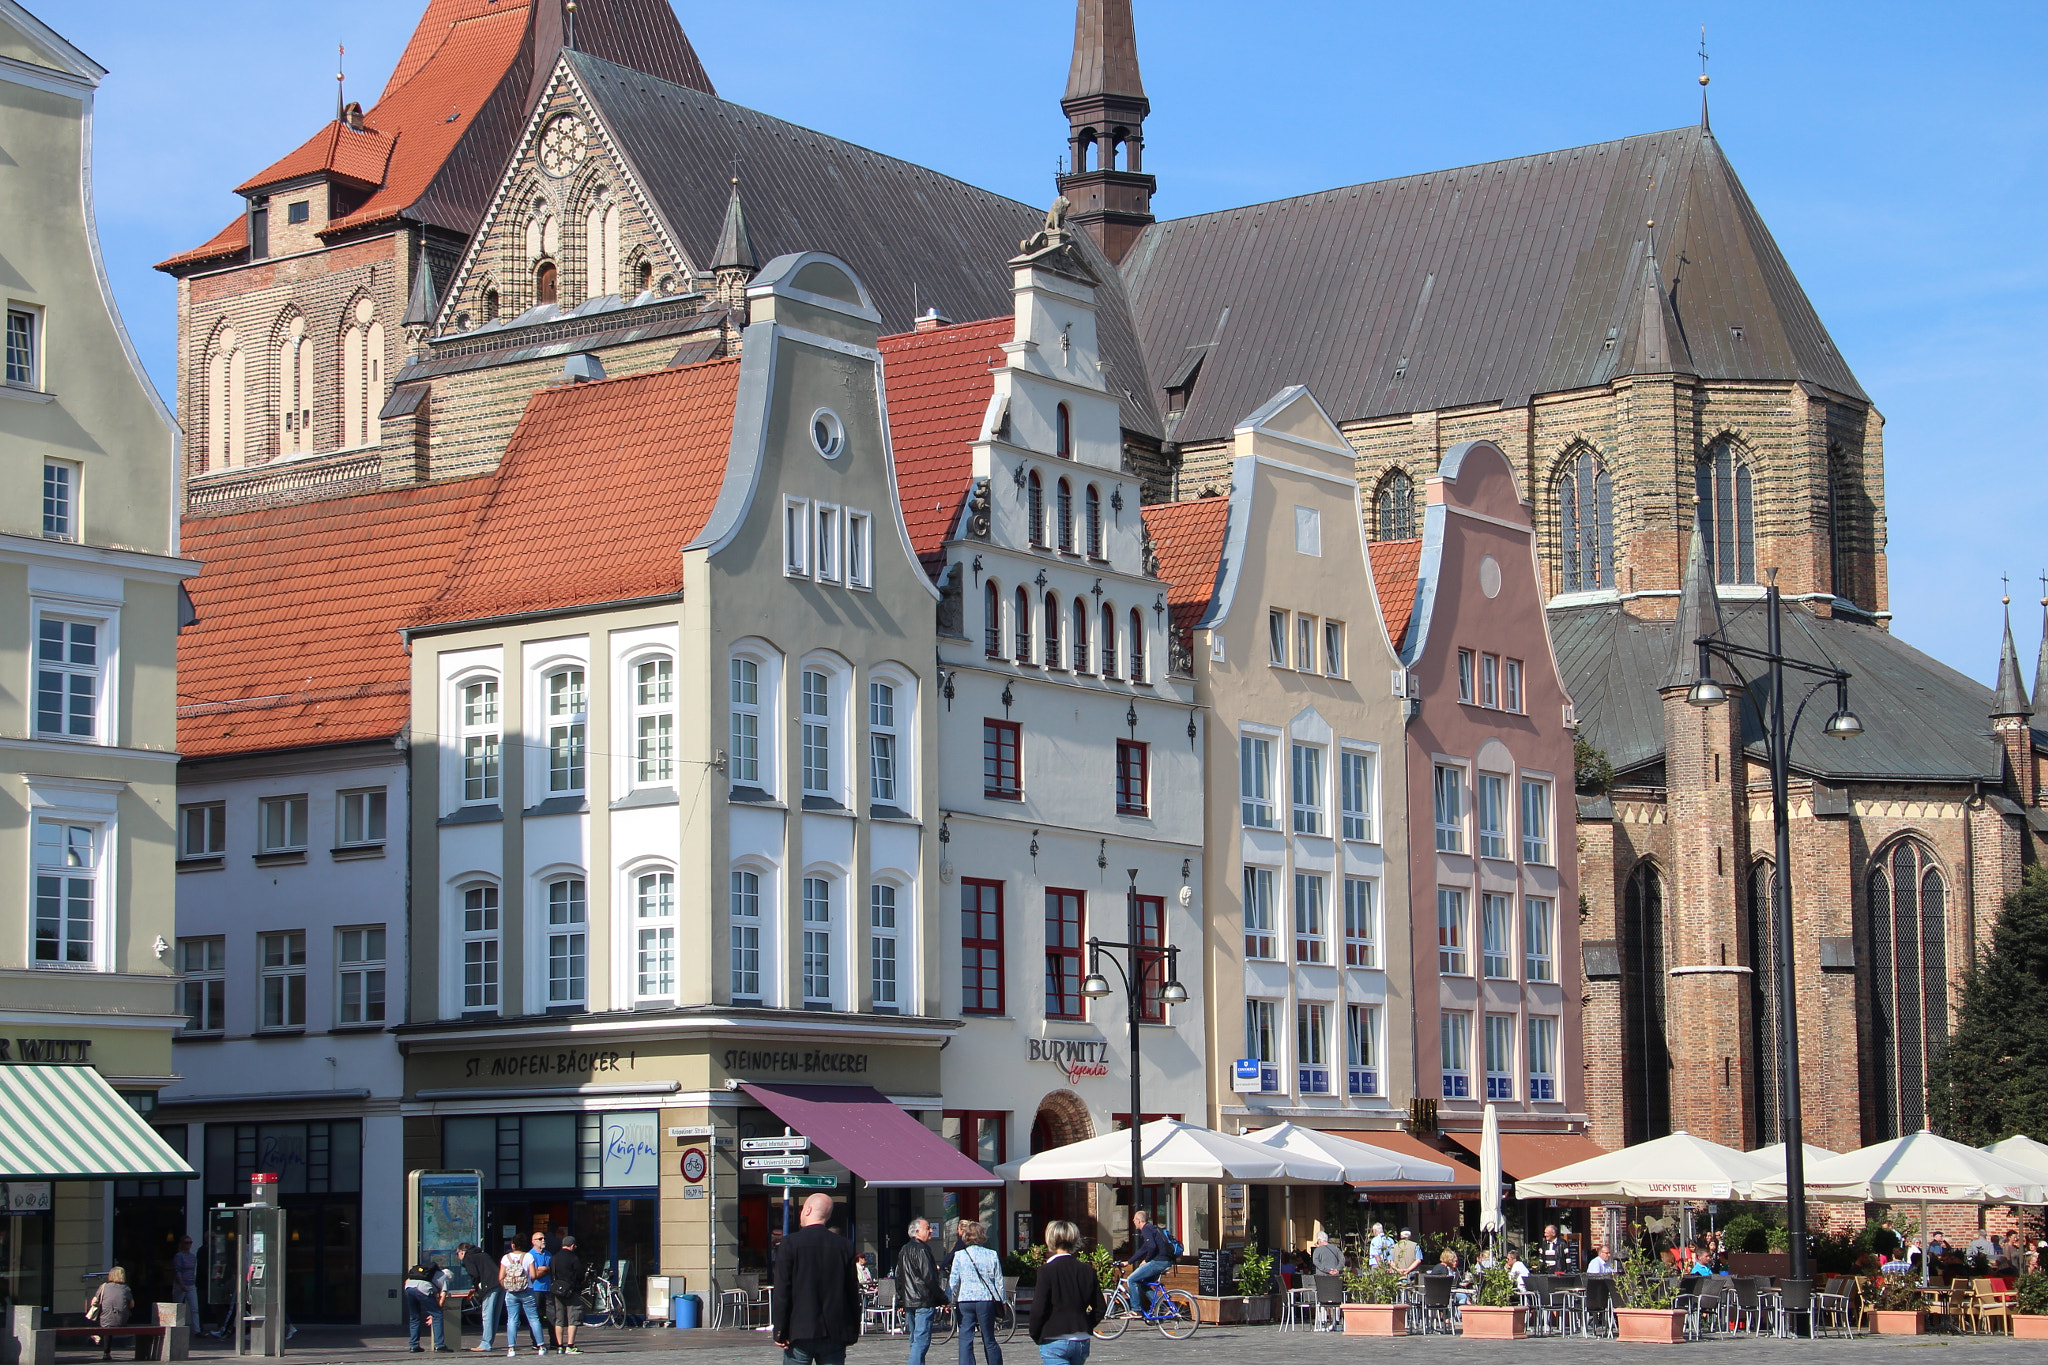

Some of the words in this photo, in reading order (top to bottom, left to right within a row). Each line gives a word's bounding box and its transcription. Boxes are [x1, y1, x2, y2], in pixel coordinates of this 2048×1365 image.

[16, 1038, 92, 1062] WITT
[724, 1050, 868, 1072] STEINOFEN-BÄCKEREI
[1029, 1039, 1109, 1070] BURWITZ
[1069, 1058, 1109, 1085] legendär
[604, 1125, 657, 1175] Rügen
[1648, 1183, 1671, 1192] LUCKY
[1673, 1184, 1697, 1192] STRIKE
[1896, 1185, 1920, 1193] LUCKY
[1922, 1186, 1949, 1194] STRIKE
